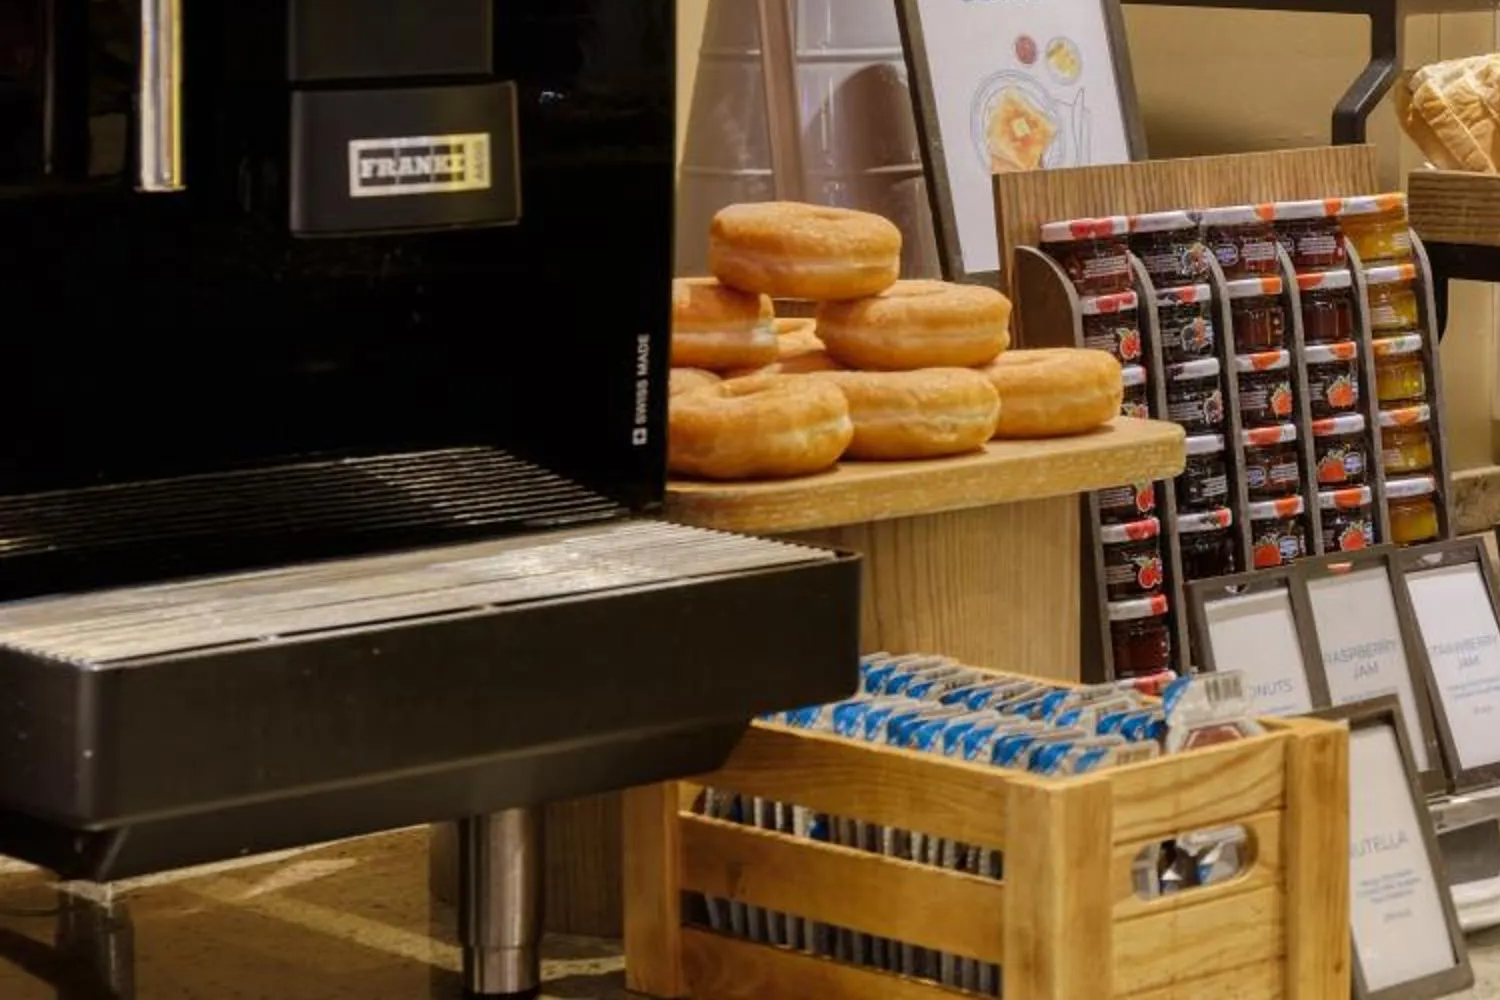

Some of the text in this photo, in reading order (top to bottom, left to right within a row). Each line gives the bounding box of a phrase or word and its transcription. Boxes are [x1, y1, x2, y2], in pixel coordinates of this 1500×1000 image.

[360, 153, 465, 179] FRANKE
[637, 333, 651, 376] MADE
[1353, 660, 1381, 682] JAM
